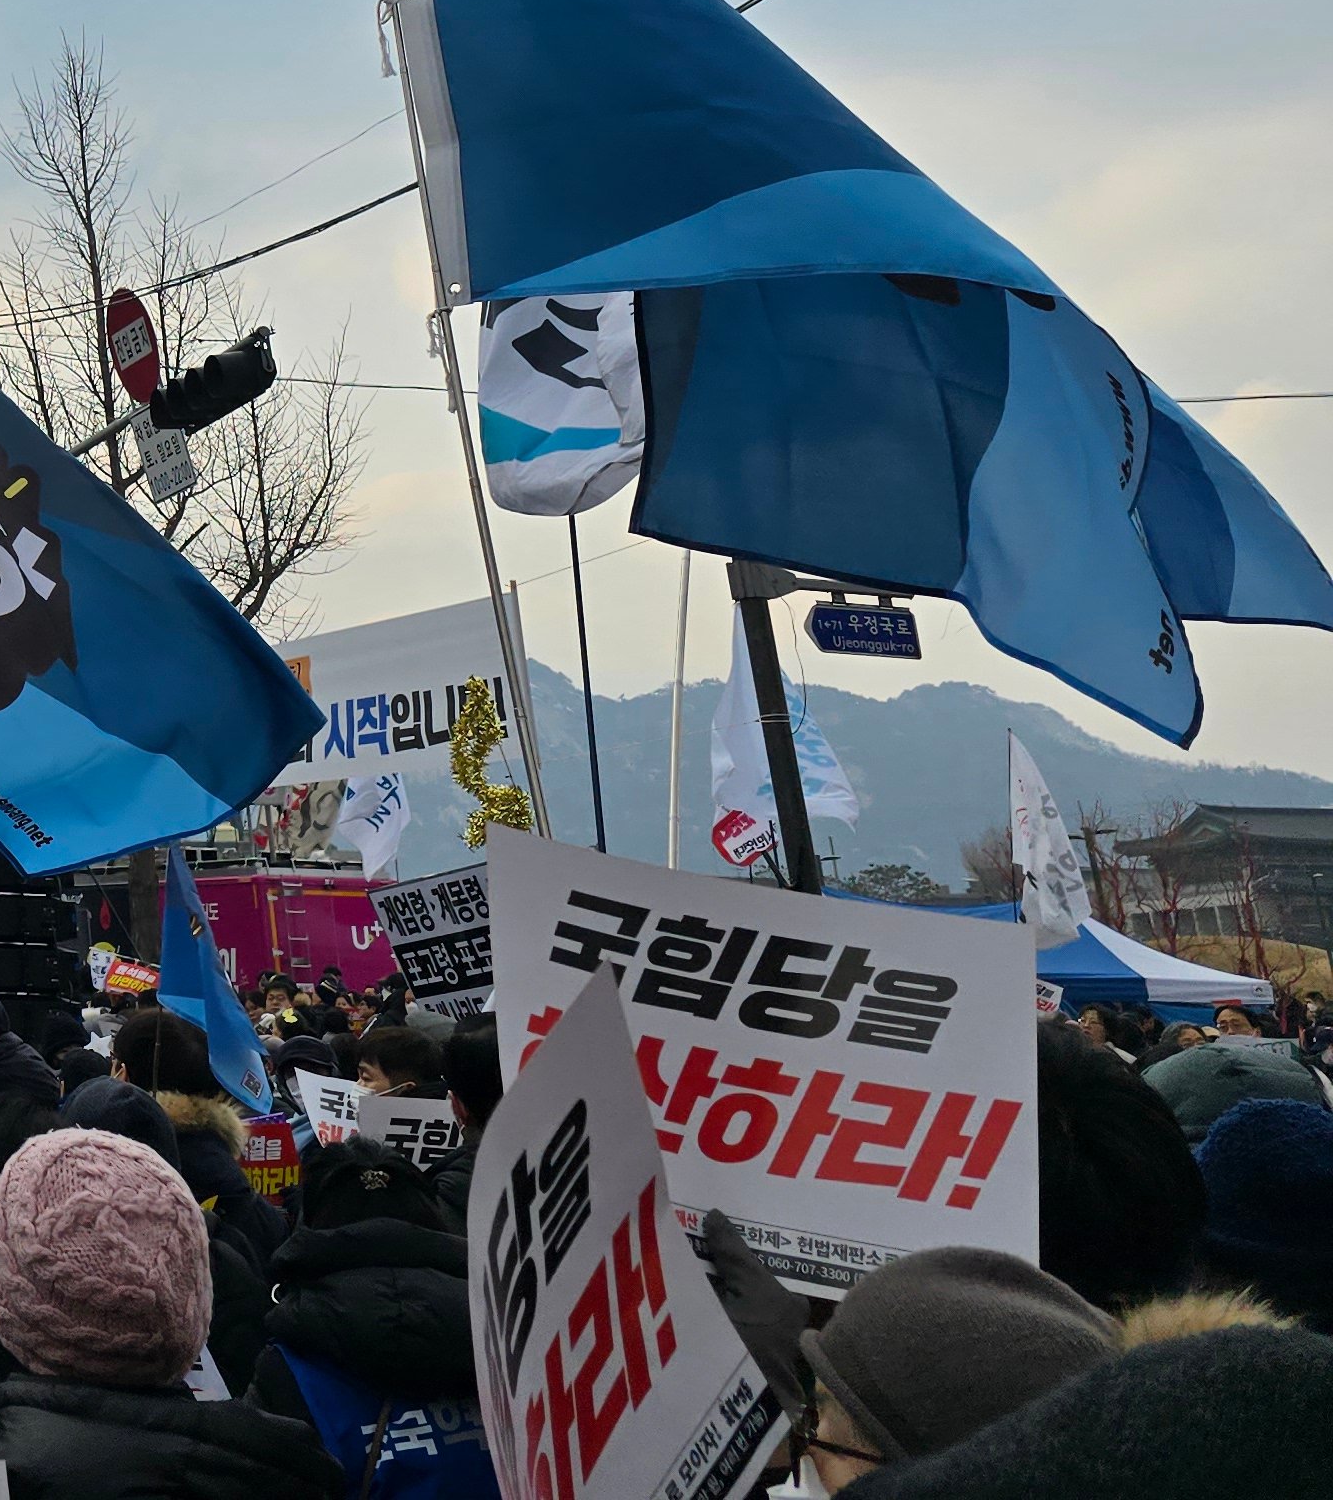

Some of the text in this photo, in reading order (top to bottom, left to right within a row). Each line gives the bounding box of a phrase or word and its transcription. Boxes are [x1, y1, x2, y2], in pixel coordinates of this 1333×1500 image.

[114, 326, 150, 364] 진입금지
[848, 614, 912, 637] 우정국로
[832, 635, 915, 654] Ujeongguk-ro
[549, 890, 959, 1055] 국힘당을
[768, 1255, 851, 1284] 060-707-3300
